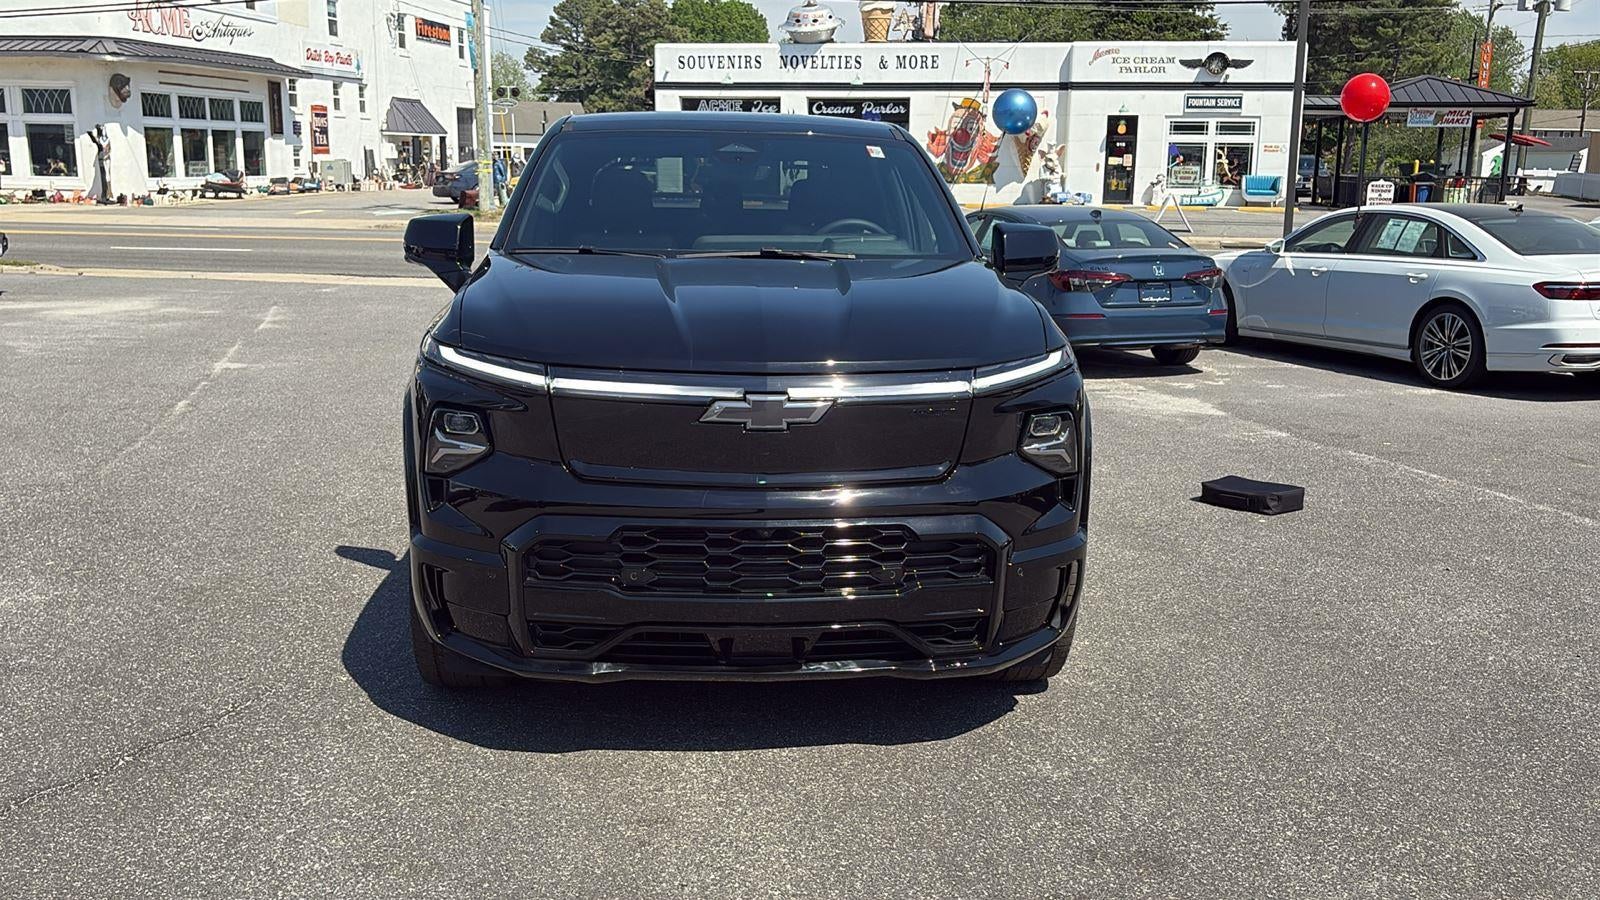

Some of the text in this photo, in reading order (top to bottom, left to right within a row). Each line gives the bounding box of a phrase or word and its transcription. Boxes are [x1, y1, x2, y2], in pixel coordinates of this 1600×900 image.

[127, 0, 254, 46] ACME Antiques
[306, 48, 353, 66] Dutch Boy Paints
[678, 55, 940, 70] SOUVENIRS NOVELTIES & MORE
[697, 100, 779, 113] ACME Ice
[812, 101, 907, 115] Cream Parlor
[1188, 98, 1241, 107] FOUNTAIN SERVICE
[315, 132, 328, 145] TEA
